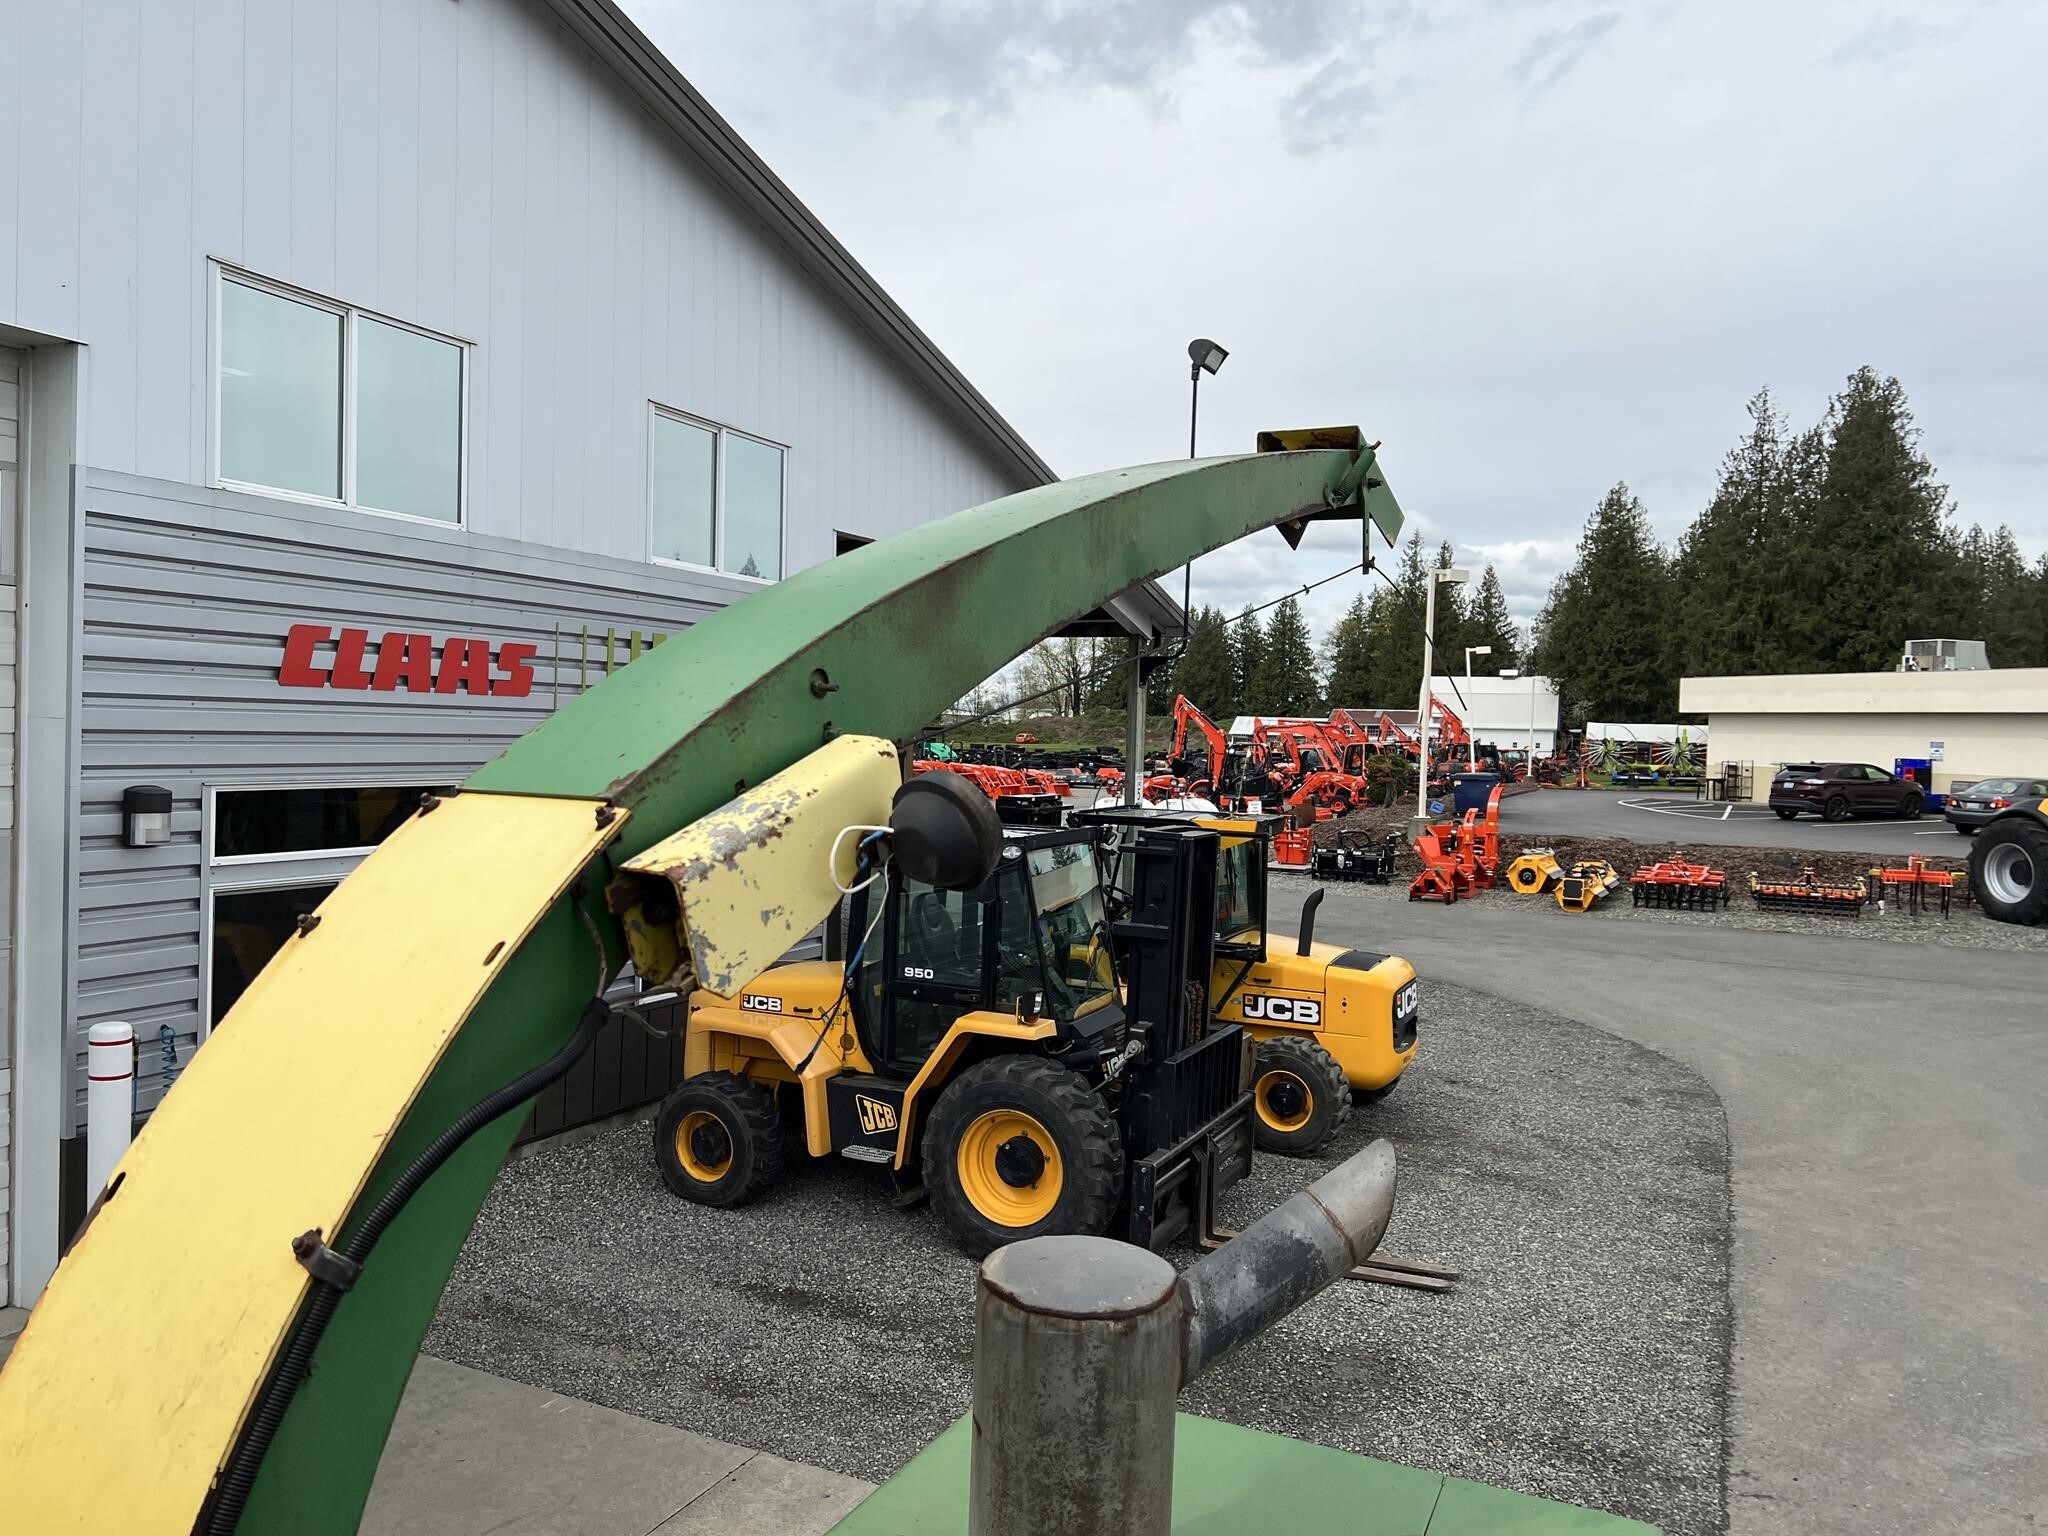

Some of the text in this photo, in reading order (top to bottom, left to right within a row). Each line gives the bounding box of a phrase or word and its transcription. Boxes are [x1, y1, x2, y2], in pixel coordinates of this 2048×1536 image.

[278, 623, 537, 698] CLAAS
[904, 966, 934, 979] 950
[743, 995, 781, 1011] JCB
[1245, 997, 1320, 1024] JCB
[1396, 982, 1417, 1019] JCB
[863, 1099, 895, 1131] JCB
